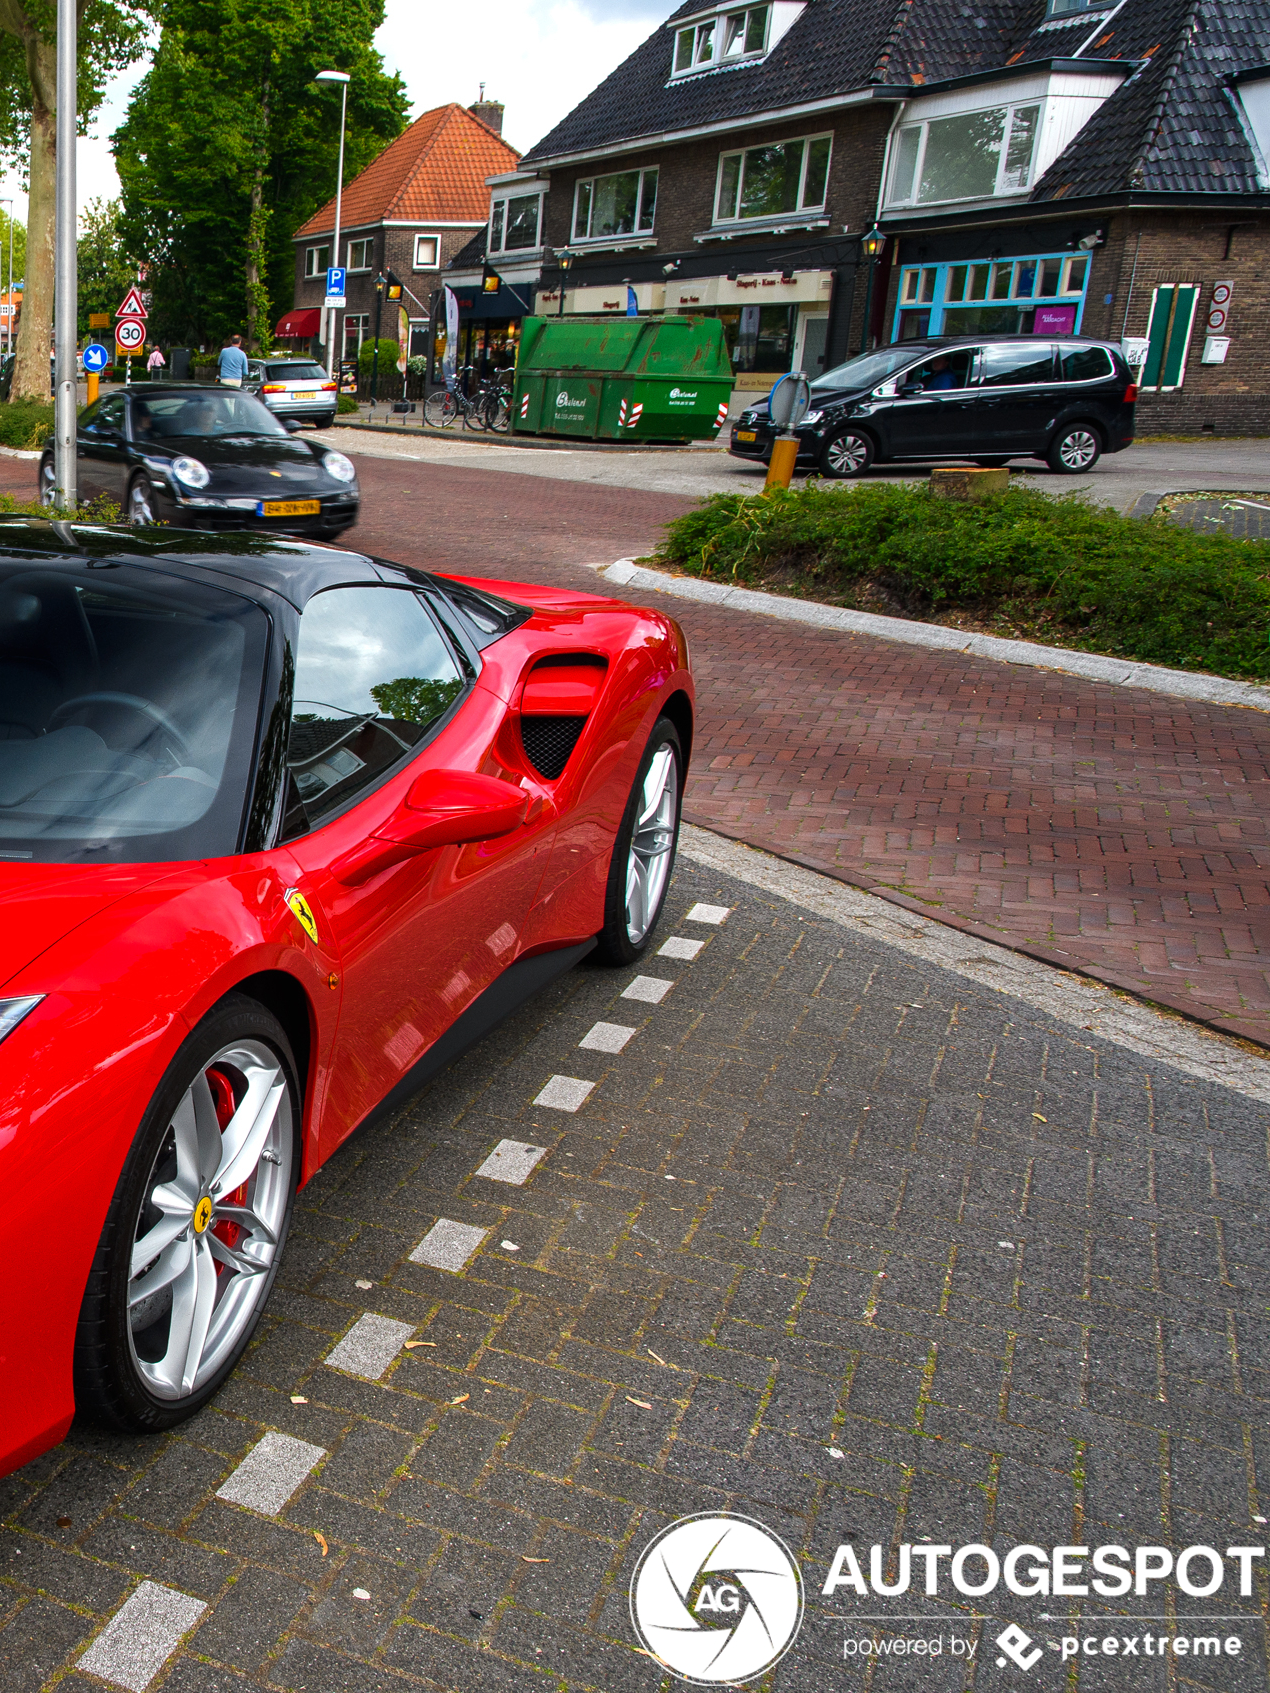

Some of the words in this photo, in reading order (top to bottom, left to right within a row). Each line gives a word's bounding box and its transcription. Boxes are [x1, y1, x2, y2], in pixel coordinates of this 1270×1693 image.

[332, 270, 342, 284] P
[736, 280, 757, 288] Slagerij
[121, 327, 141, 341] 30
